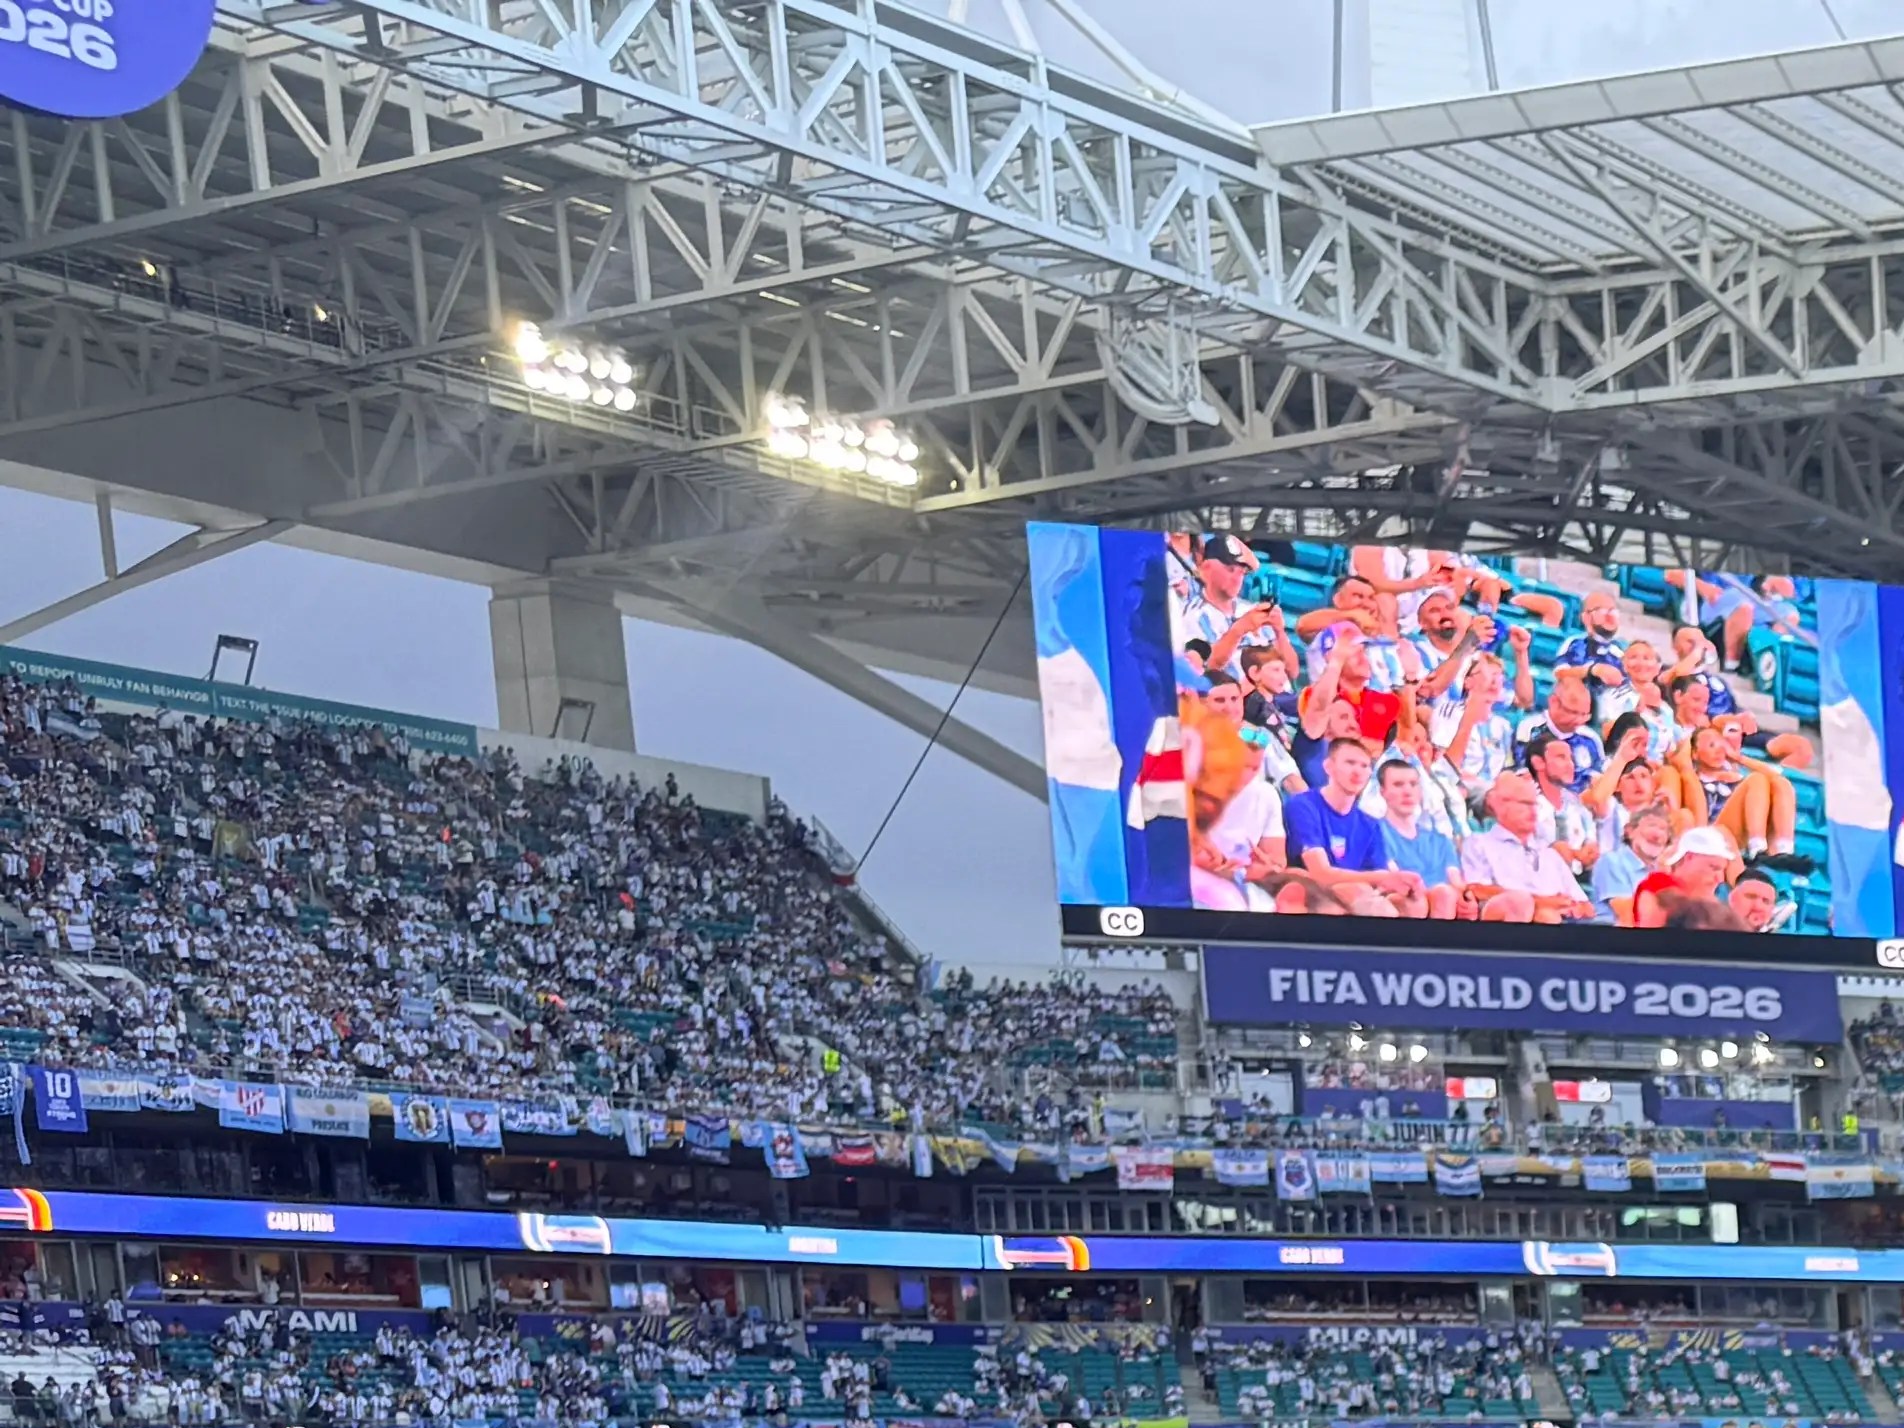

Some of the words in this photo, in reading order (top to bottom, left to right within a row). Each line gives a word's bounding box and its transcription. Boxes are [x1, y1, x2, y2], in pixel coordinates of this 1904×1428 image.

[80, 673, 123, 690] UNRULY
[127, 681, 150, 694] FAN
[152, 684, 209, 704] BEHAVIOR
[220, 696, 248, 710] TEXT
[250, 700, 271, 714] THE
[1107, 913, 1139, 930] CC
[1269, 967, 1367, 1004] FIFA
[1368, 972, 1532, 1011] WORLD
[1539, 978, 1628, 1014] CUP
[1633, 985, 1783, 1021] 2026
[45, 1070, 72, 1098] 10
